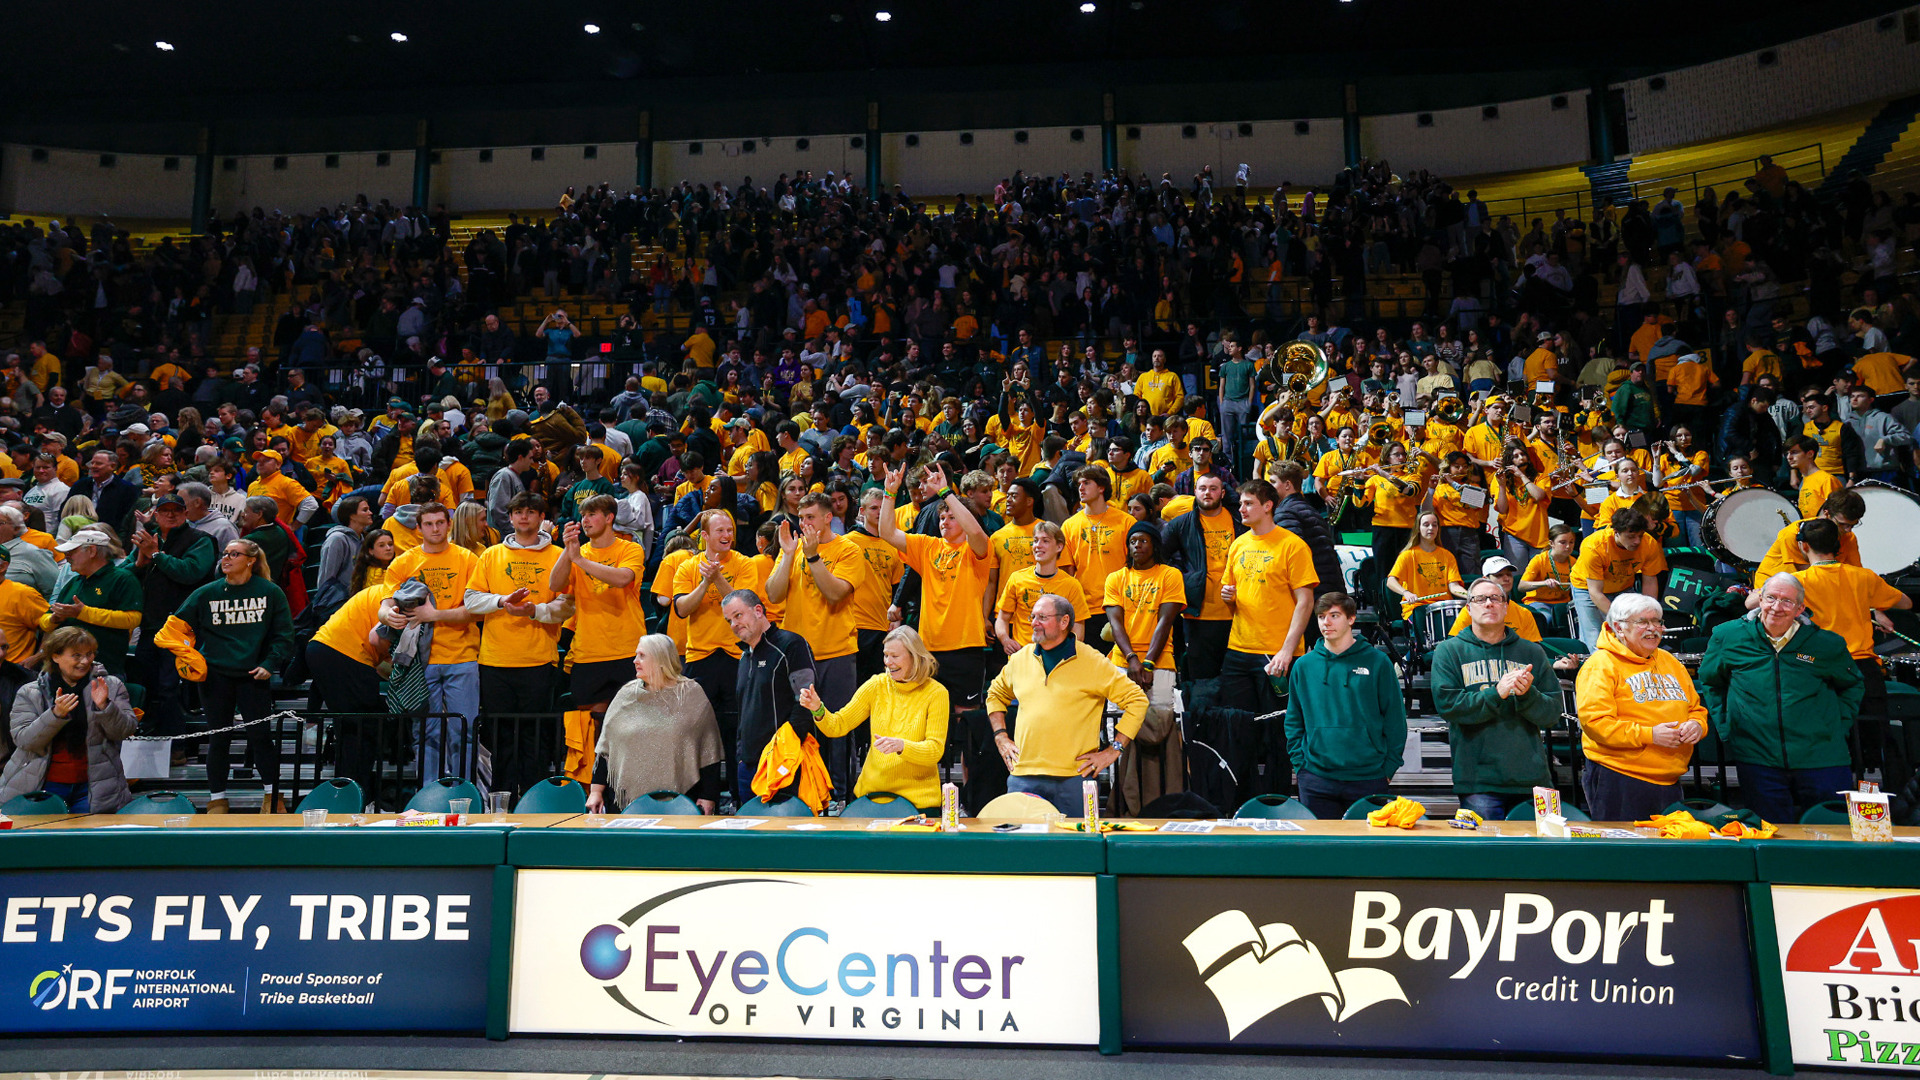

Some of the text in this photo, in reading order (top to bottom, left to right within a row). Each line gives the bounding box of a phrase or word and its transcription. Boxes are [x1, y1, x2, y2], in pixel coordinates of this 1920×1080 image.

[209, 596, 267, 613] WILLIAM
[212, 609, 265, 625] & MARY
[152, 895, 270, 950] FLY,
[290, 894, 471, 941] TRIBE
[1347, 891, 1675, 979] BayPort
[135, 969, 196, 980] NORFOLK
[645, 924, 1025, 1016] EyeCenter
[134, 983, 236, 994] INTERNATIONAL
[260, 973, 383, 988] Proud Sponsor of
[29, 969, 134, 1011] ORF
[259, 992, 375, 1005] Tribe Basketball
[1495, 975, 1674, 1005] Credit Union
[132, 997, 190, 1008] AIRPORT
[709, 1003, 1019, 1032] OF VIRGINIA
